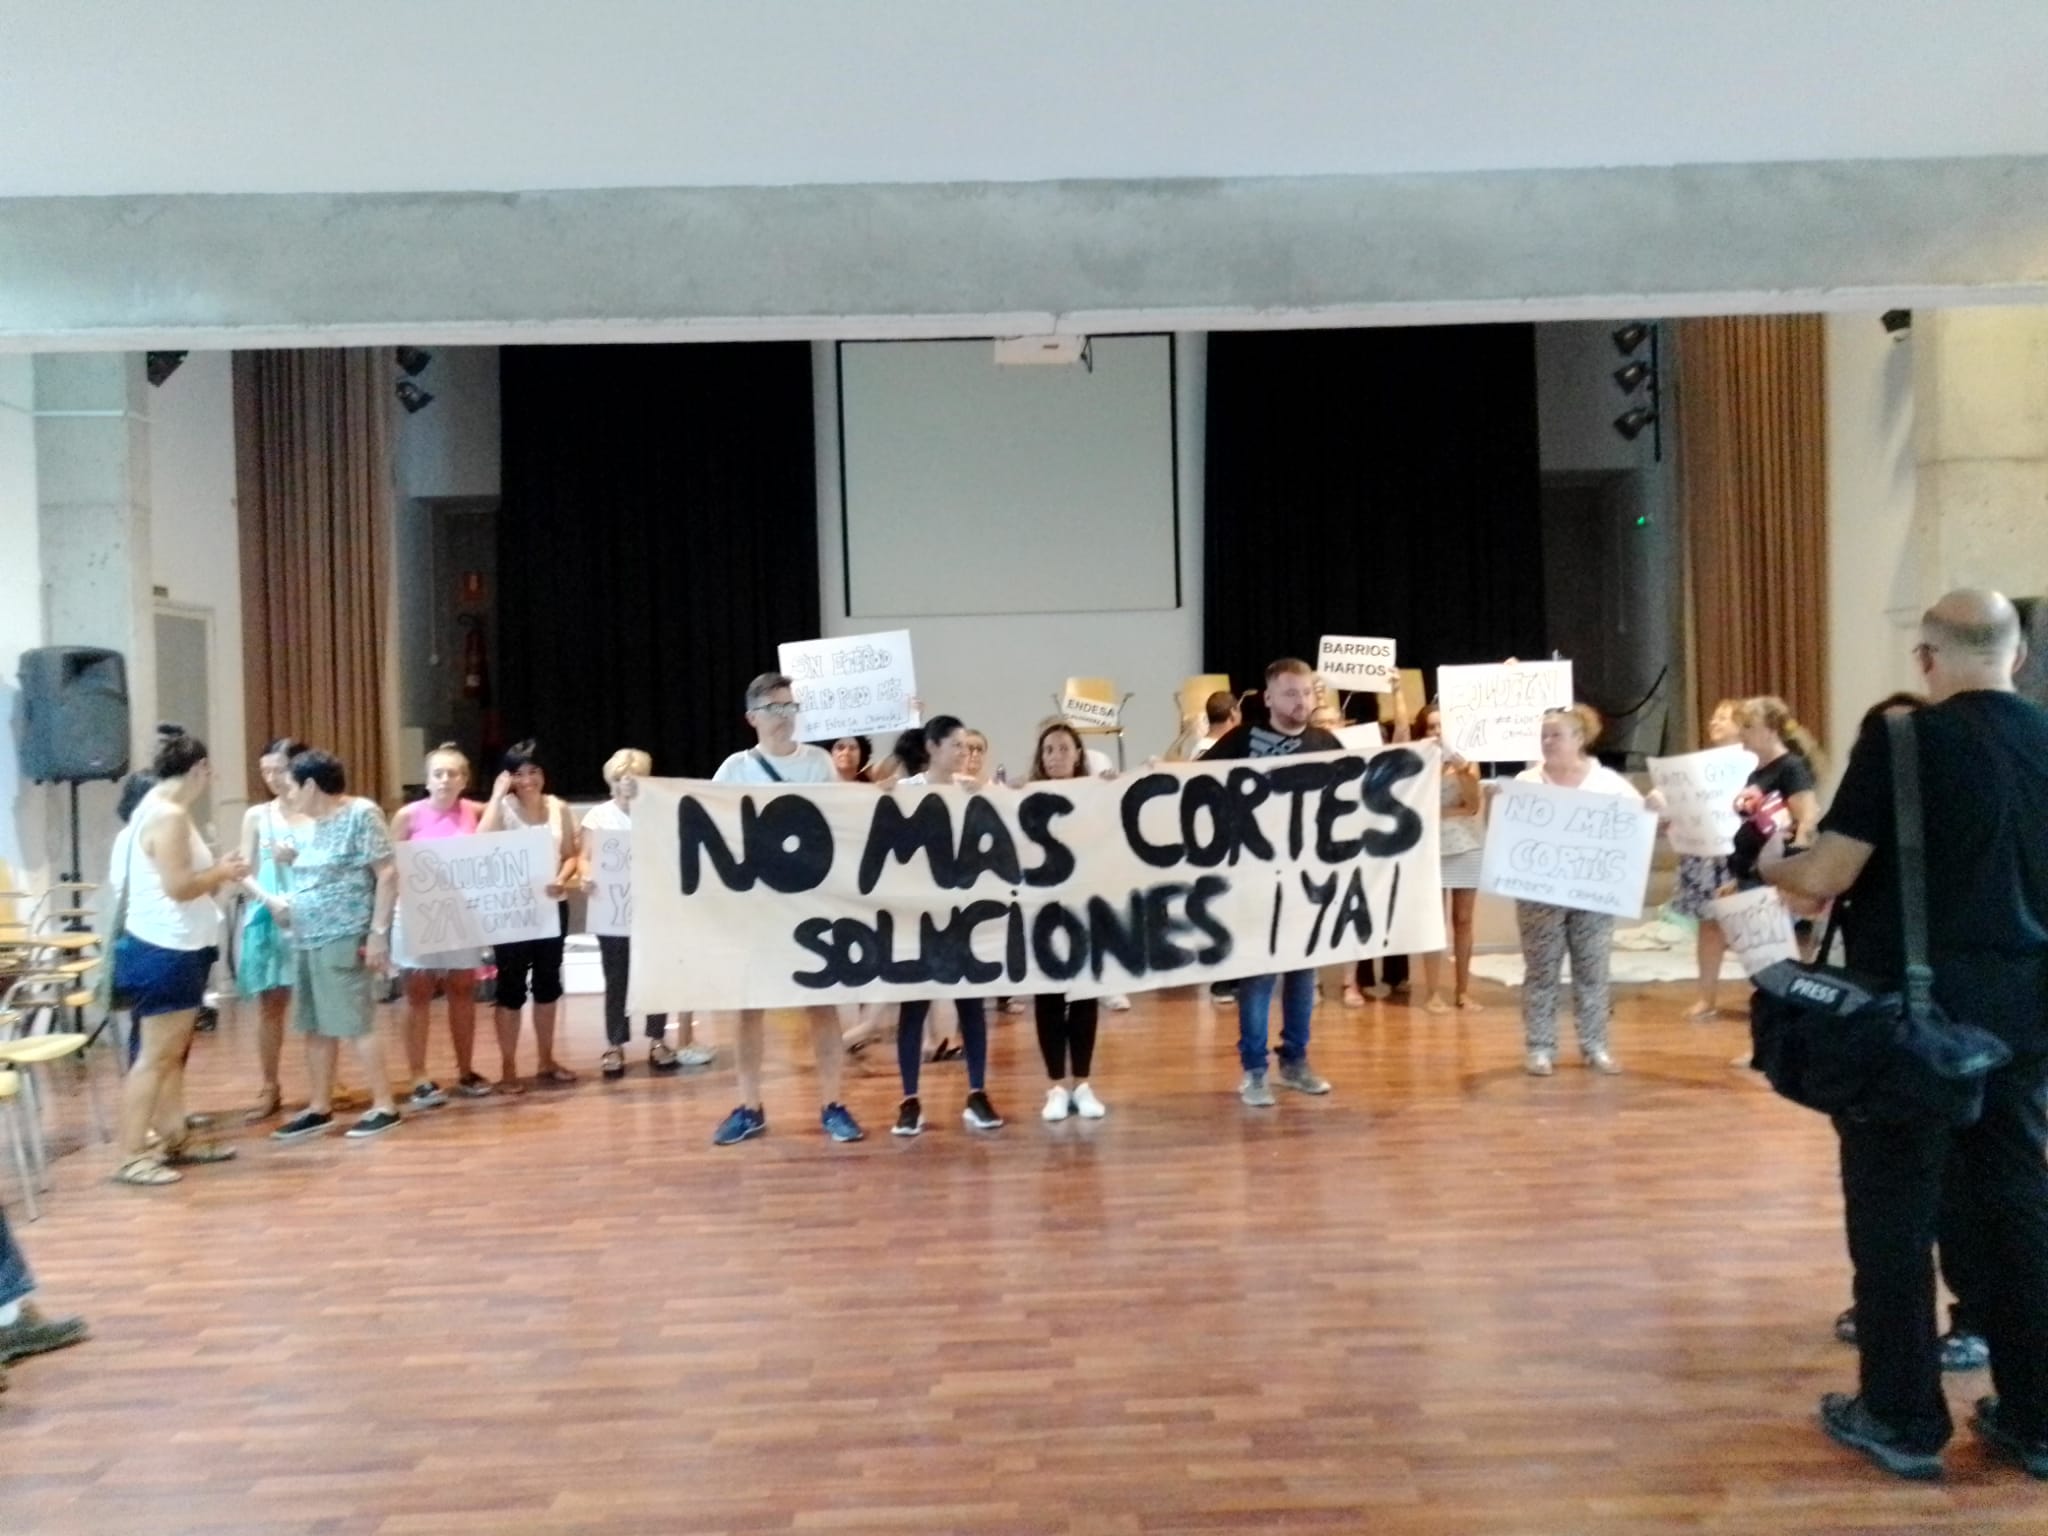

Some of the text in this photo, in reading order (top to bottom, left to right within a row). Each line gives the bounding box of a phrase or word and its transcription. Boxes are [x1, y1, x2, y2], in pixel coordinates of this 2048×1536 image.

[1322, 642, 1391, 657] BARRIOS
[1323, 661, 1387, 676] HARTOS
[1067, 699, 1115, 717] ENDESA
[678, 749, 1424, 895] NO MAS CORTES
[1505, 794, 1554, 828] NO
[408, 847, 530, 893] SOLUCIÓN
[416, 899, 467, 944] YA
[793, 874, 1233, 988] SOLUCIONES
[1790, 977, 1840, 1004] PRESS
